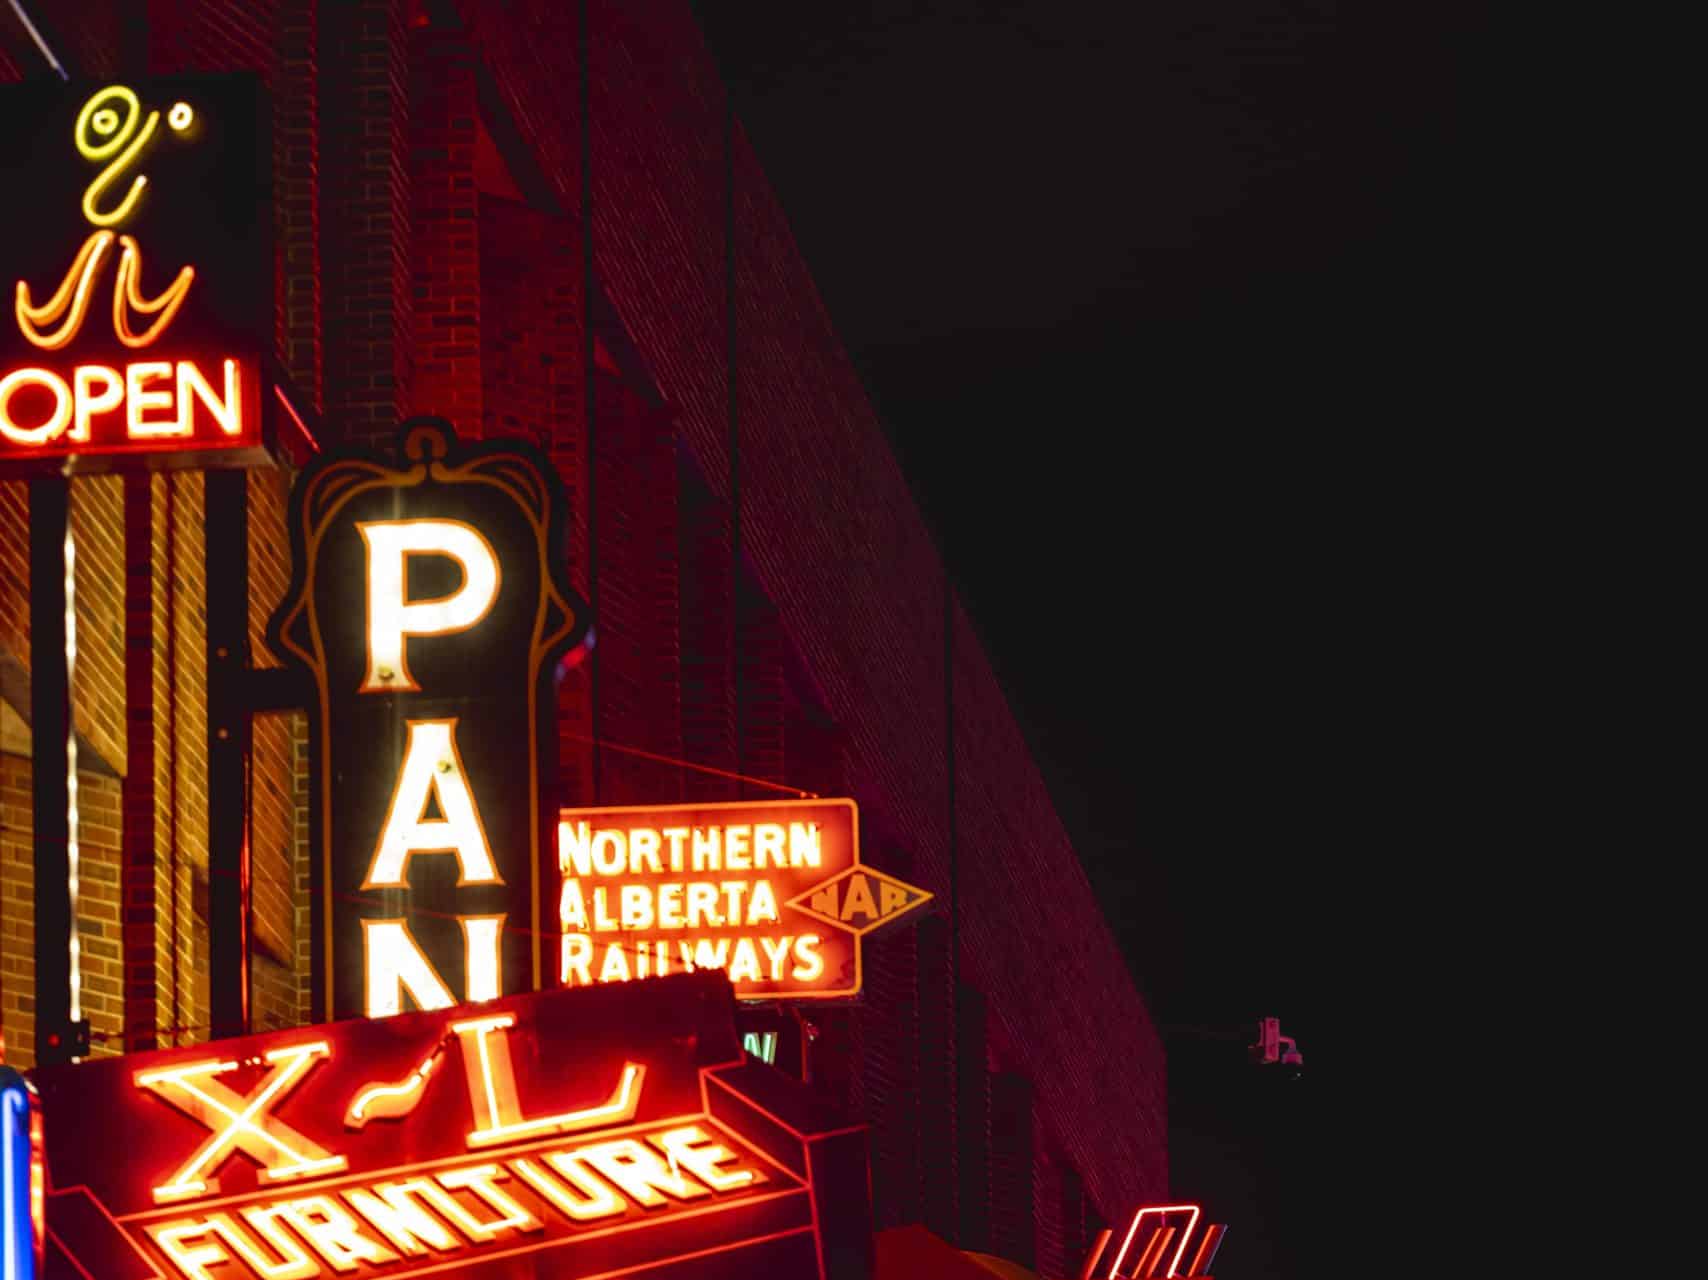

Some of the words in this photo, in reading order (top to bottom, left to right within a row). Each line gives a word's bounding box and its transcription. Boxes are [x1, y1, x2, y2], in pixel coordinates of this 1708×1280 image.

[0, 358, 242, 443] OPEN
[558, 821, 822, 876] NORTHERN
[560, 878, 779, 933] ALBERTA
[811, 873, 907, 921] NAR
